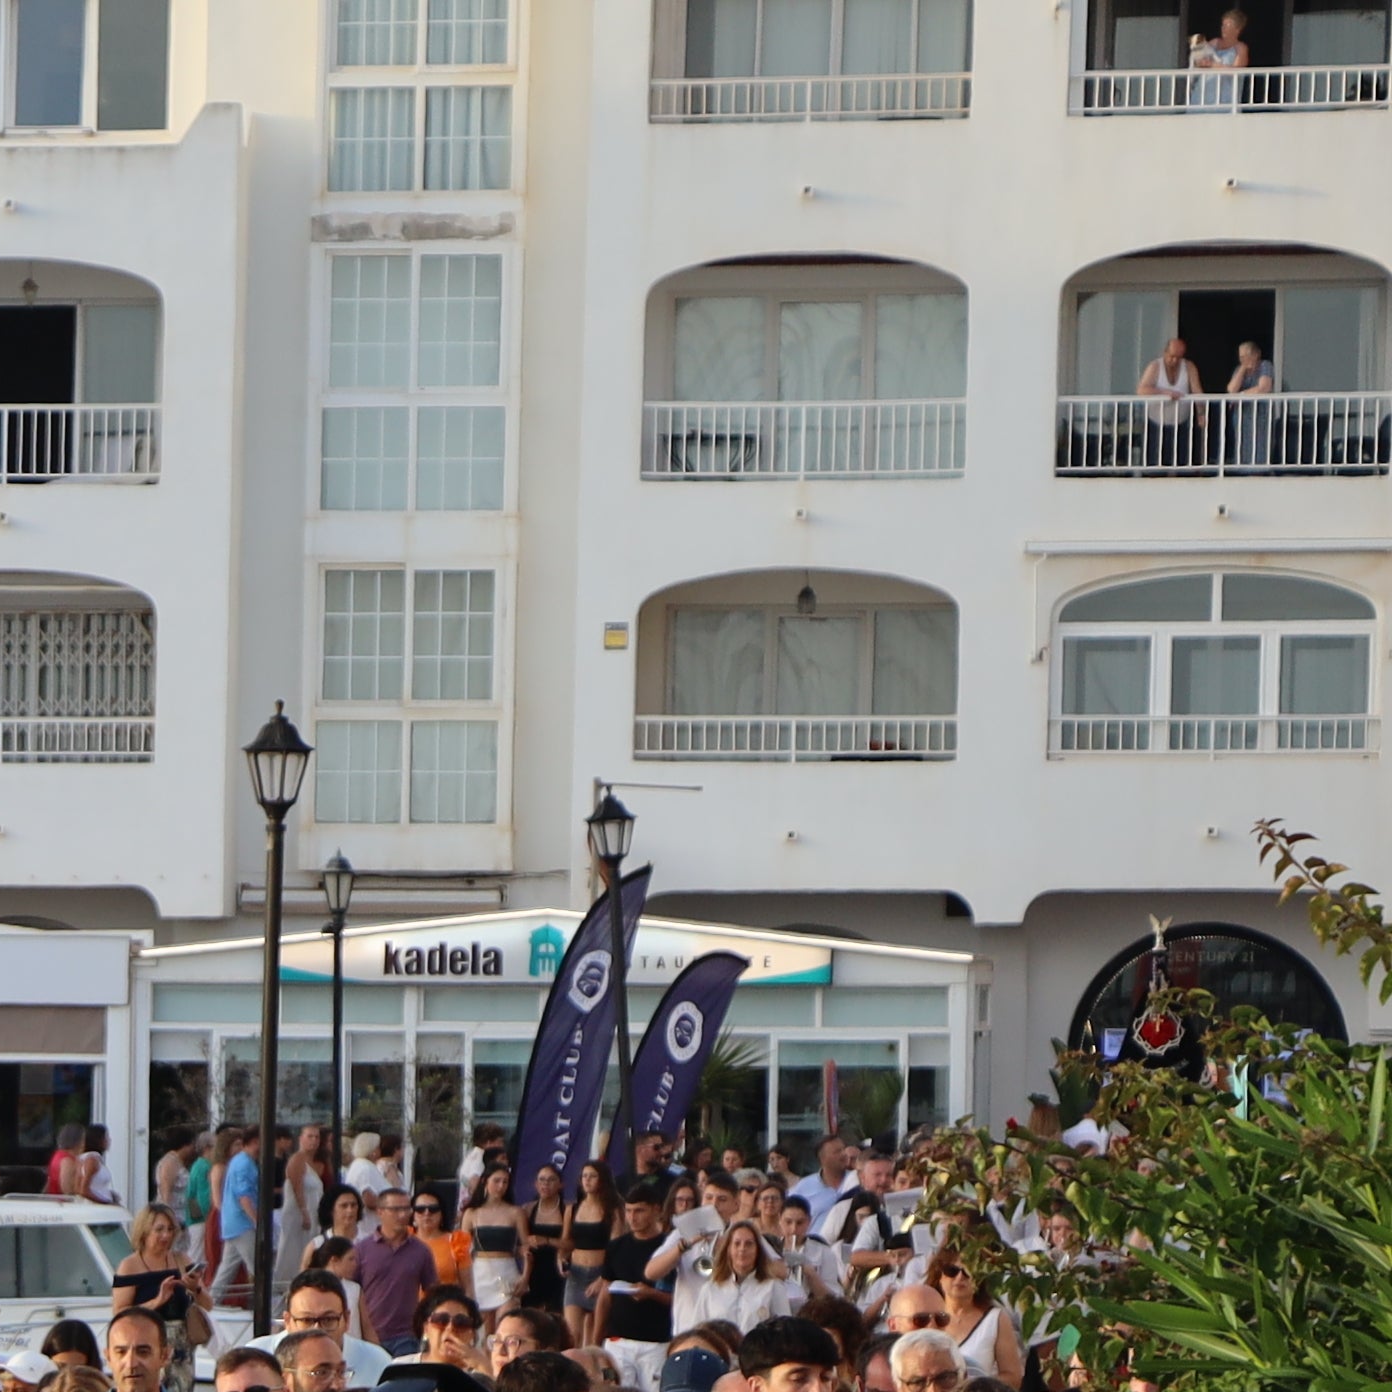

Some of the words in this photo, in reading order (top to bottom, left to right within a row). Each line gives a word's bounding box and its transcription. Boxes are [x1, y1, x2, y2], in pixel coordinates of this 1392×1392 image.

[383, 941, 503, 975] kadela
[560, 1027, 583, 1107] CLUB
[551, 1111, 571, 1170] OAT
